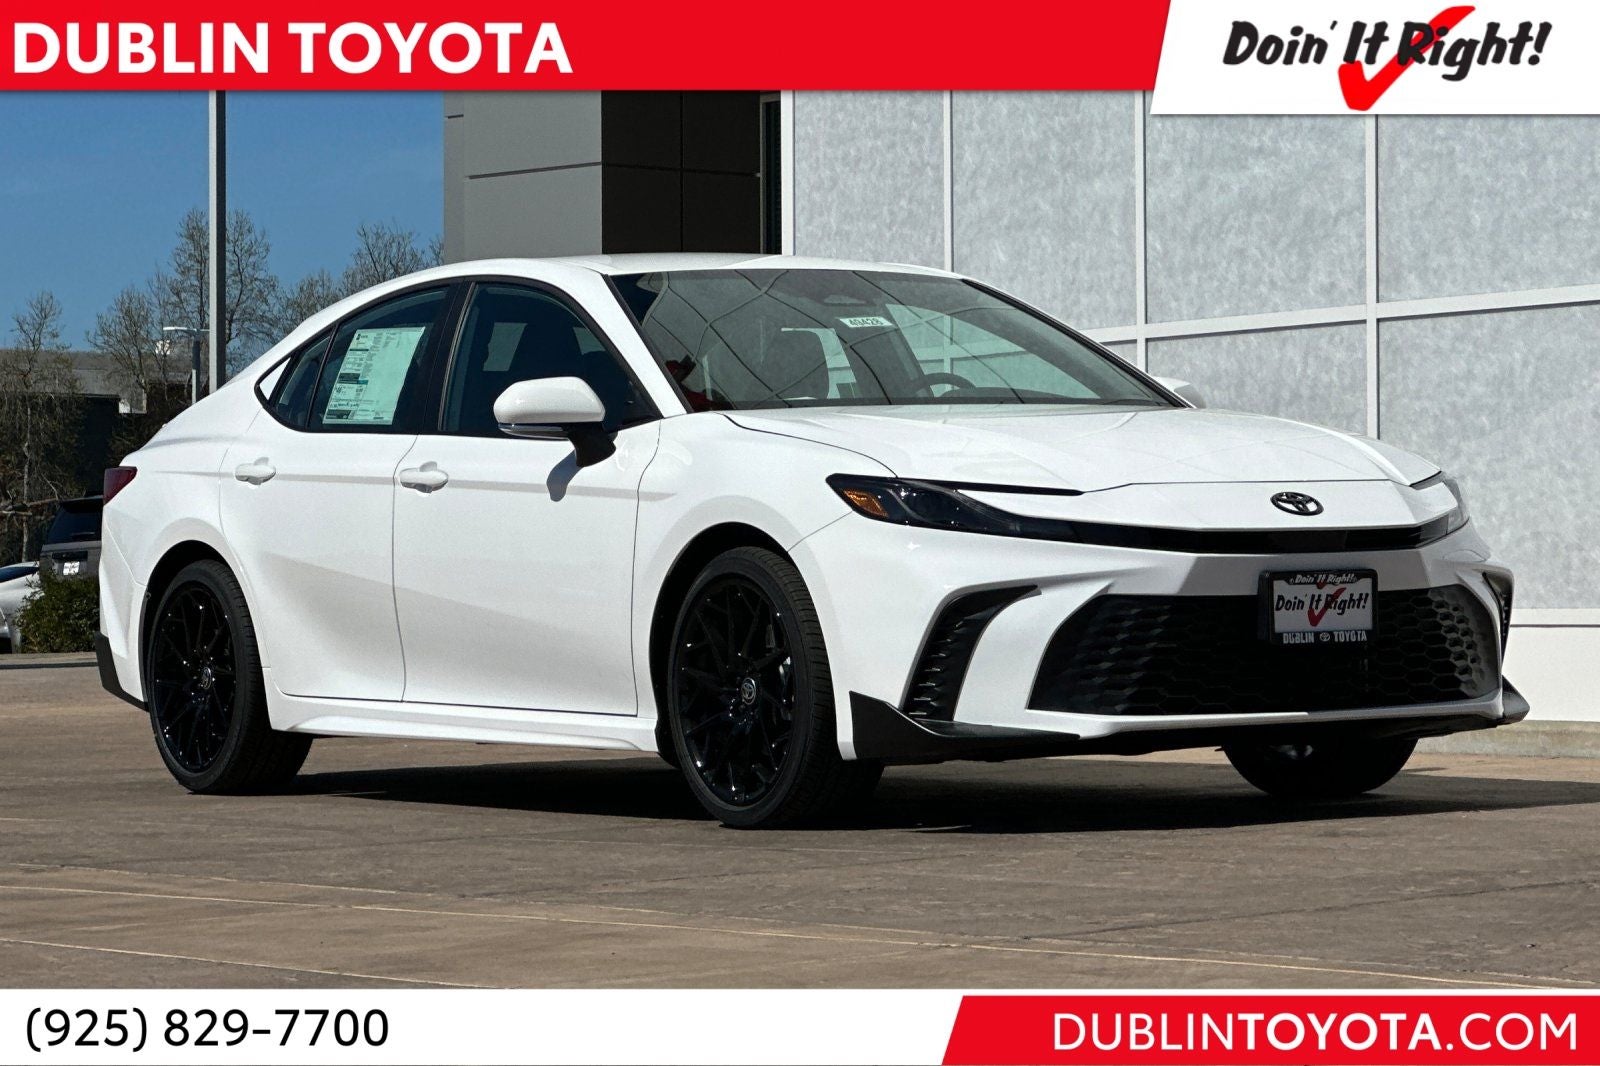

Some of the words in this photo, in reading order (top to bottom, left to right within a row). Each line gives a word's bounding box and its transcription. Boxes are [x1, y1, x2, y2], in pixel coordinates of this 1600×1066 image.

[1327, 573, 1354, 585] Right!
[1275, 593, 1307, 611] Doin'
[1309, 593, 1322, 610] It
[1323, 592, 1369, 616] Right!
[1283, 632, 1314, 644] DUBLIN
[1333, 630, 1368, 643] TOYOTA
